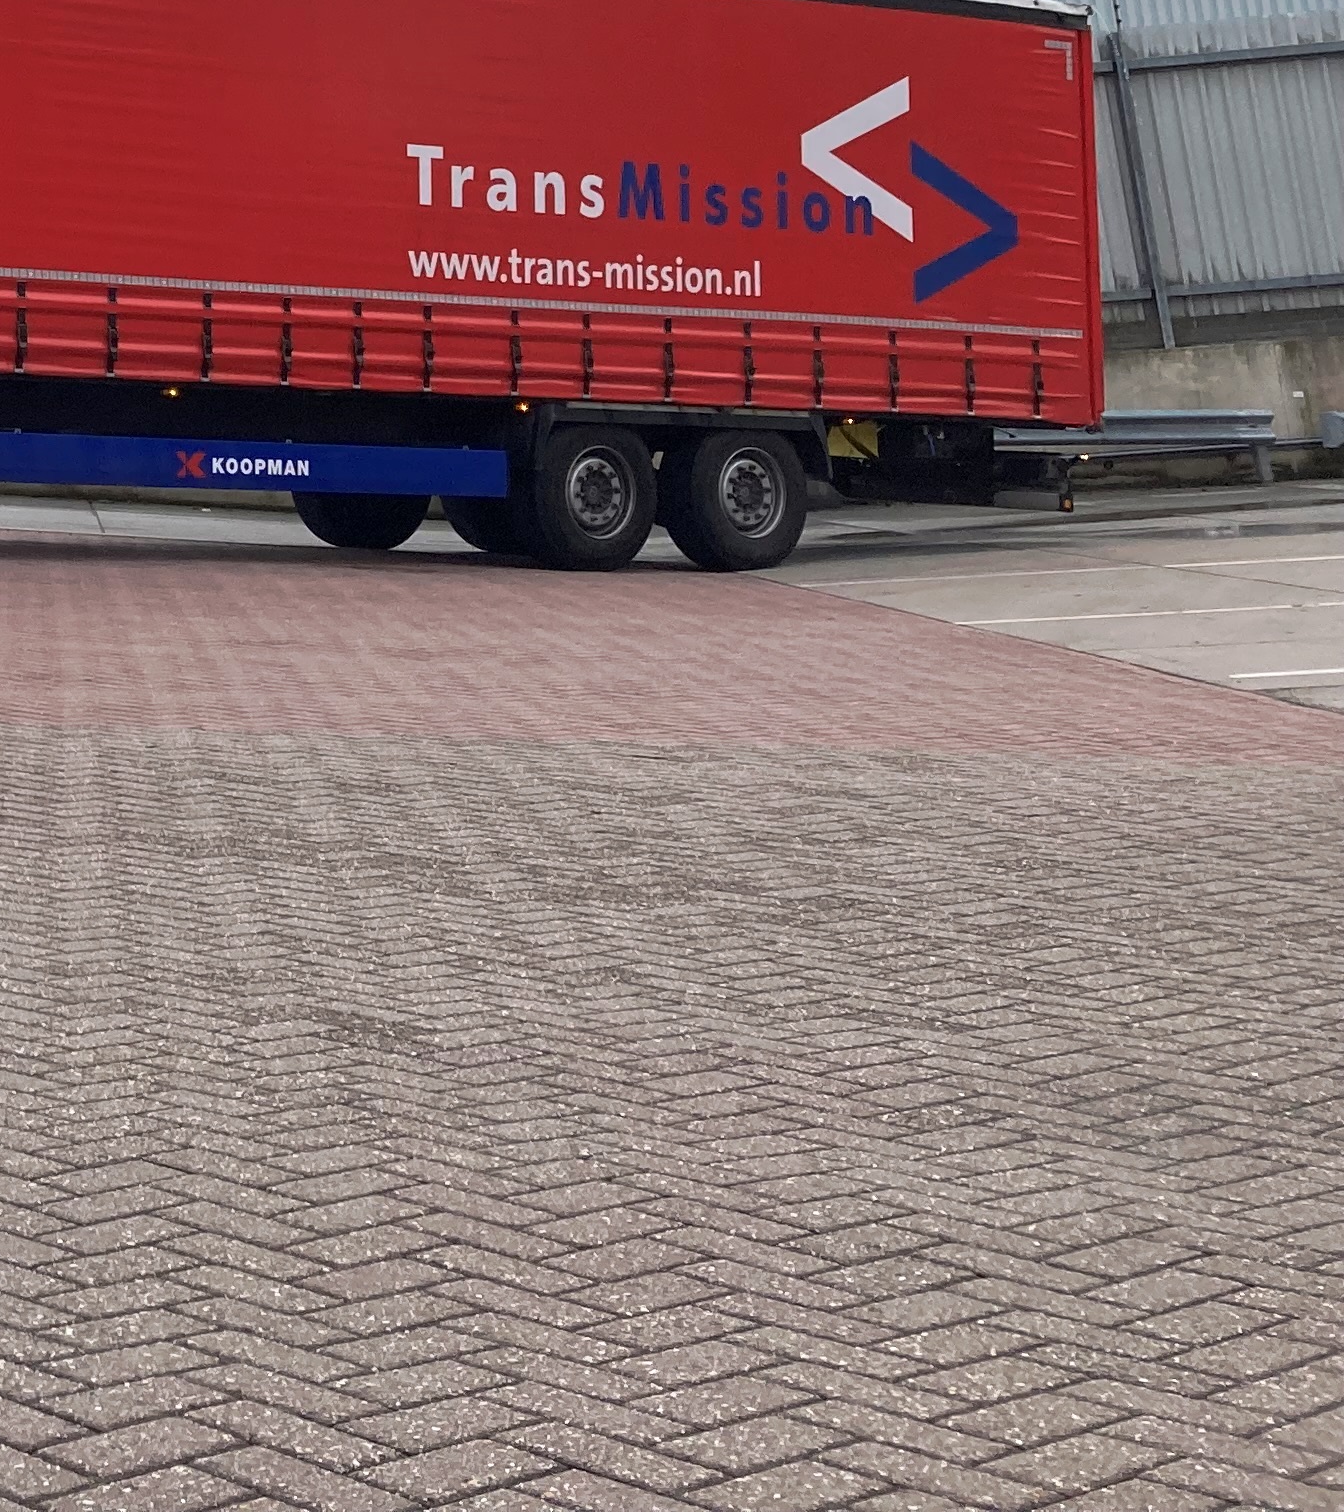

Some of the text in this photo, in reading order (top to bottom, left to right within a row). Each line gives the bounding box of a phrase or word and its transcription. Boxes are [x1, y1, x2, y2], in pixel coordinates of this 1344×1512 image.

[406, 143, 874, 236] TransMission
[407, 248, 762, 297] www.trans-mission.nl
[212, 457, 310, 477] KOOPMAN
